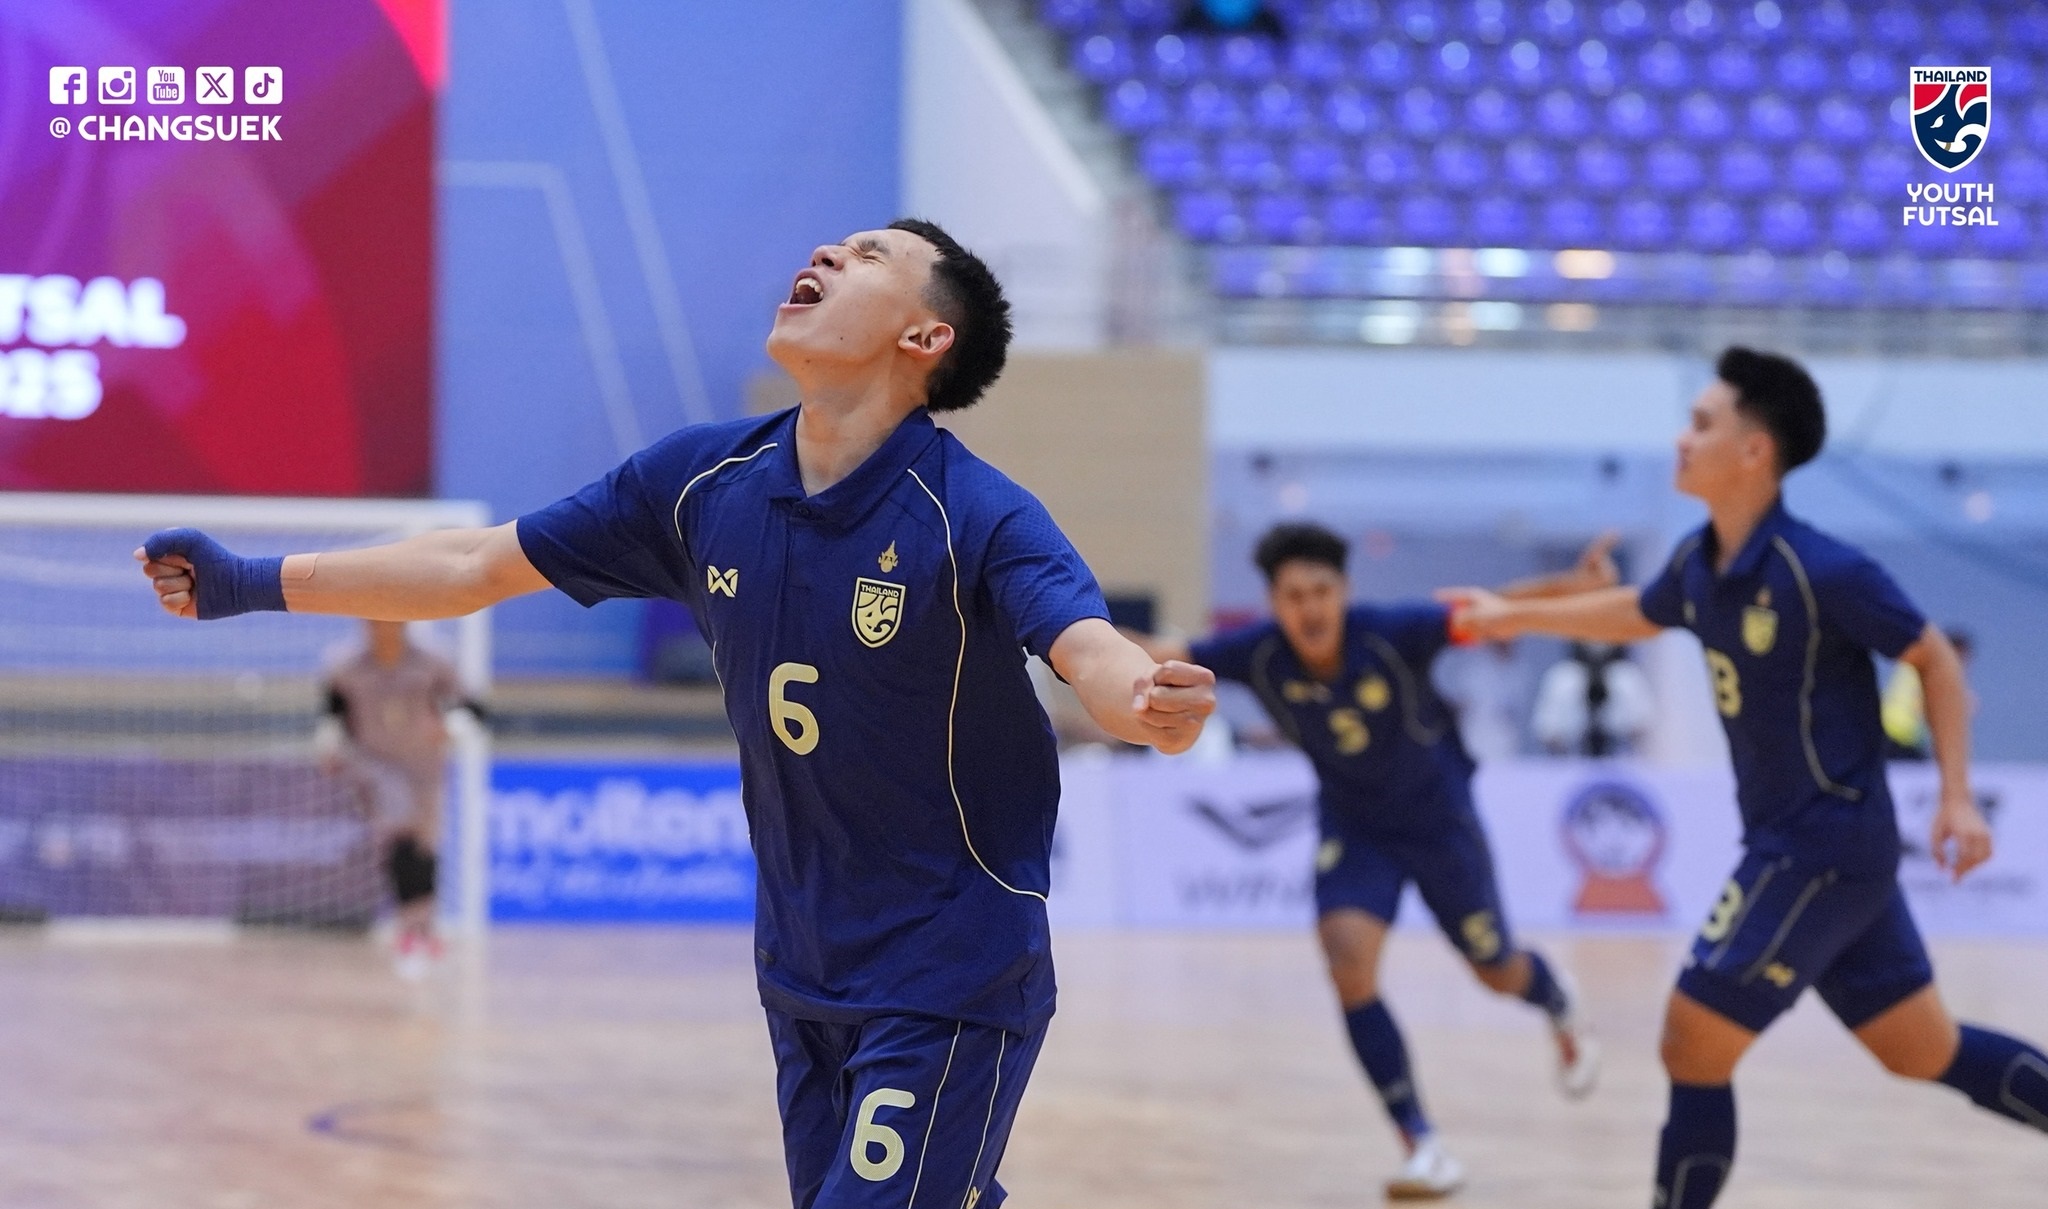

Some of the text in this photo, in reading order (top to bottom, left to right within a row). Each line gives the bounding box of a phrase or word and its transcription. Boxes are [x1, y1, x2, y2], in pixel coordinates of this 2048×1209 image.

[0, 348, 104, 420] 25
[861, 584, 900, 598] THAILAND
[768, 662, 819, 756] 6
[850, 1088, 916, 1182] 6
